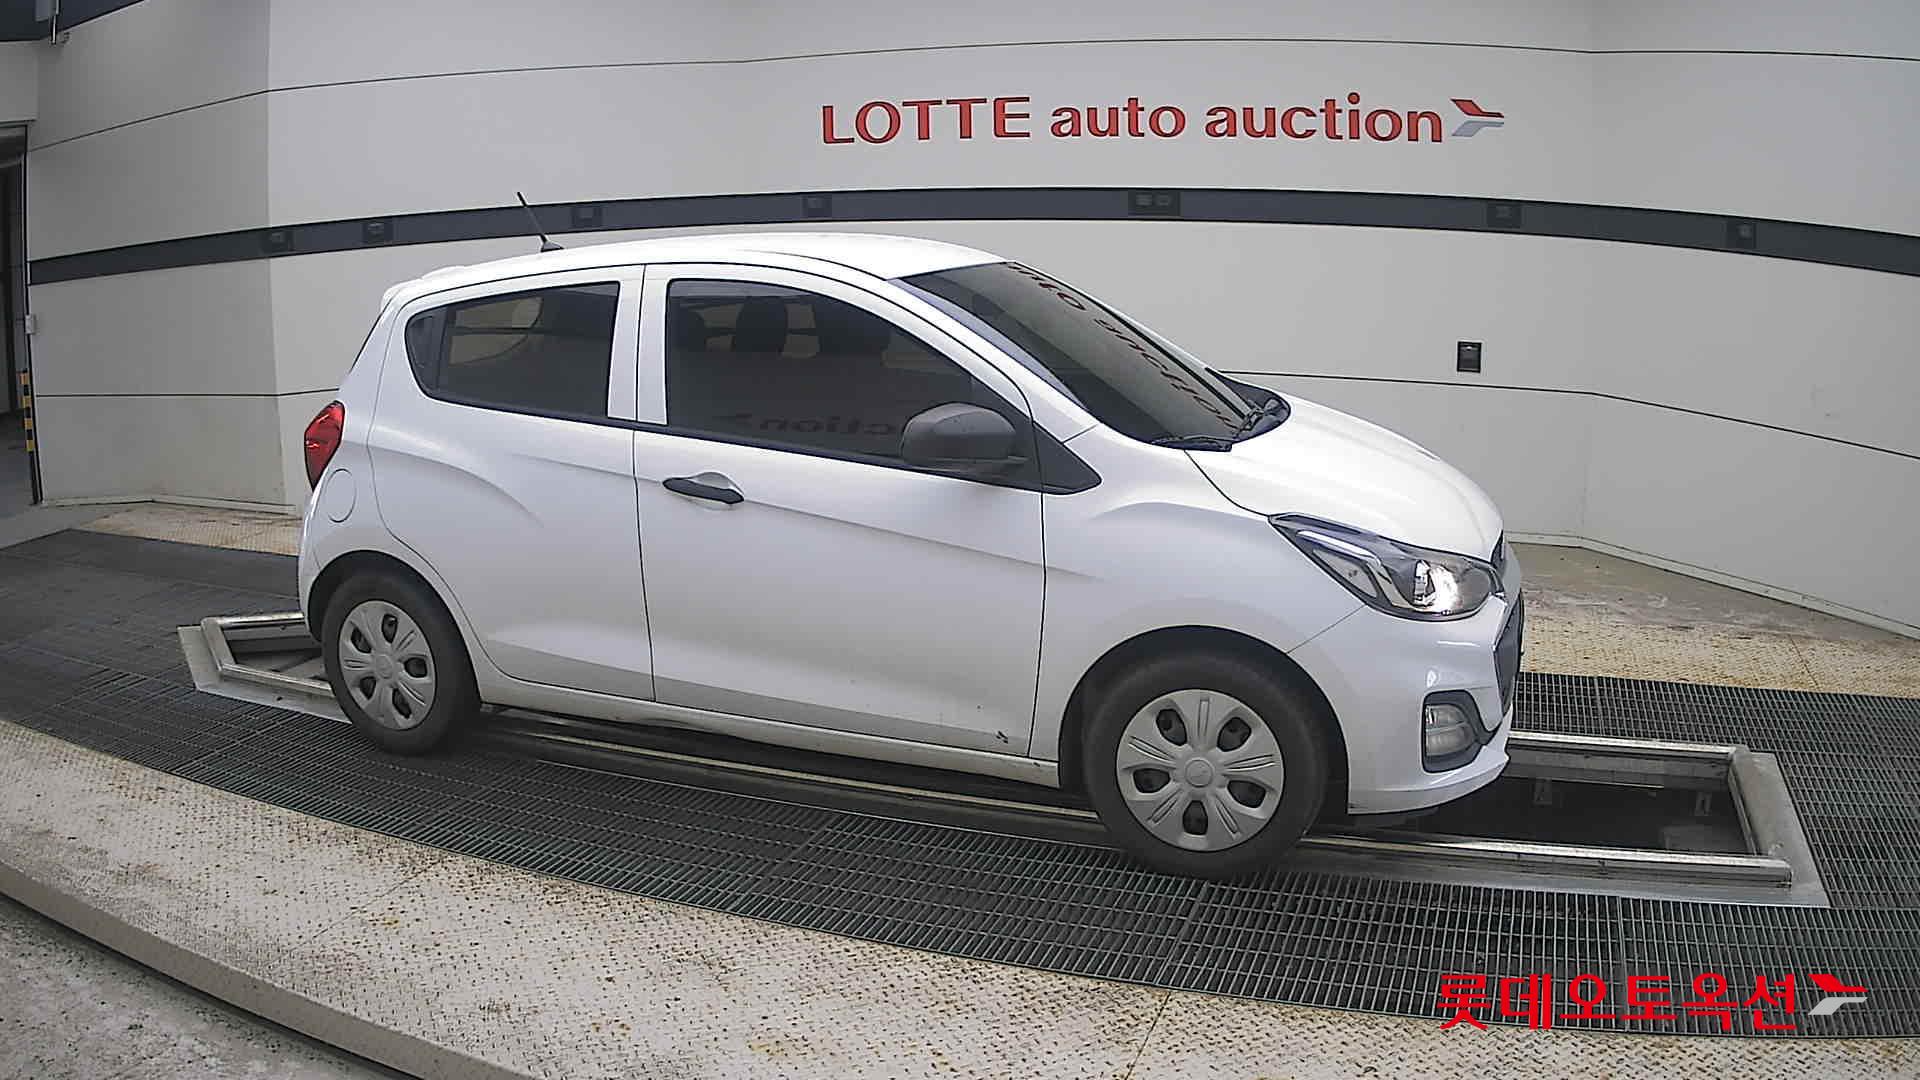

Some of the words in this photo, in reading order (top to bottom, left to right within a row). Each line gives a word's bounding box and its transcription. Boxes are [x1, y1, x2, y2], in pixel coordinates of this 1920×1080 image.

[822, 96, 1030, 144] LOTTE
[1050, 97, 1187, 139] auto
[1204, 92, 1443, 142] auction
